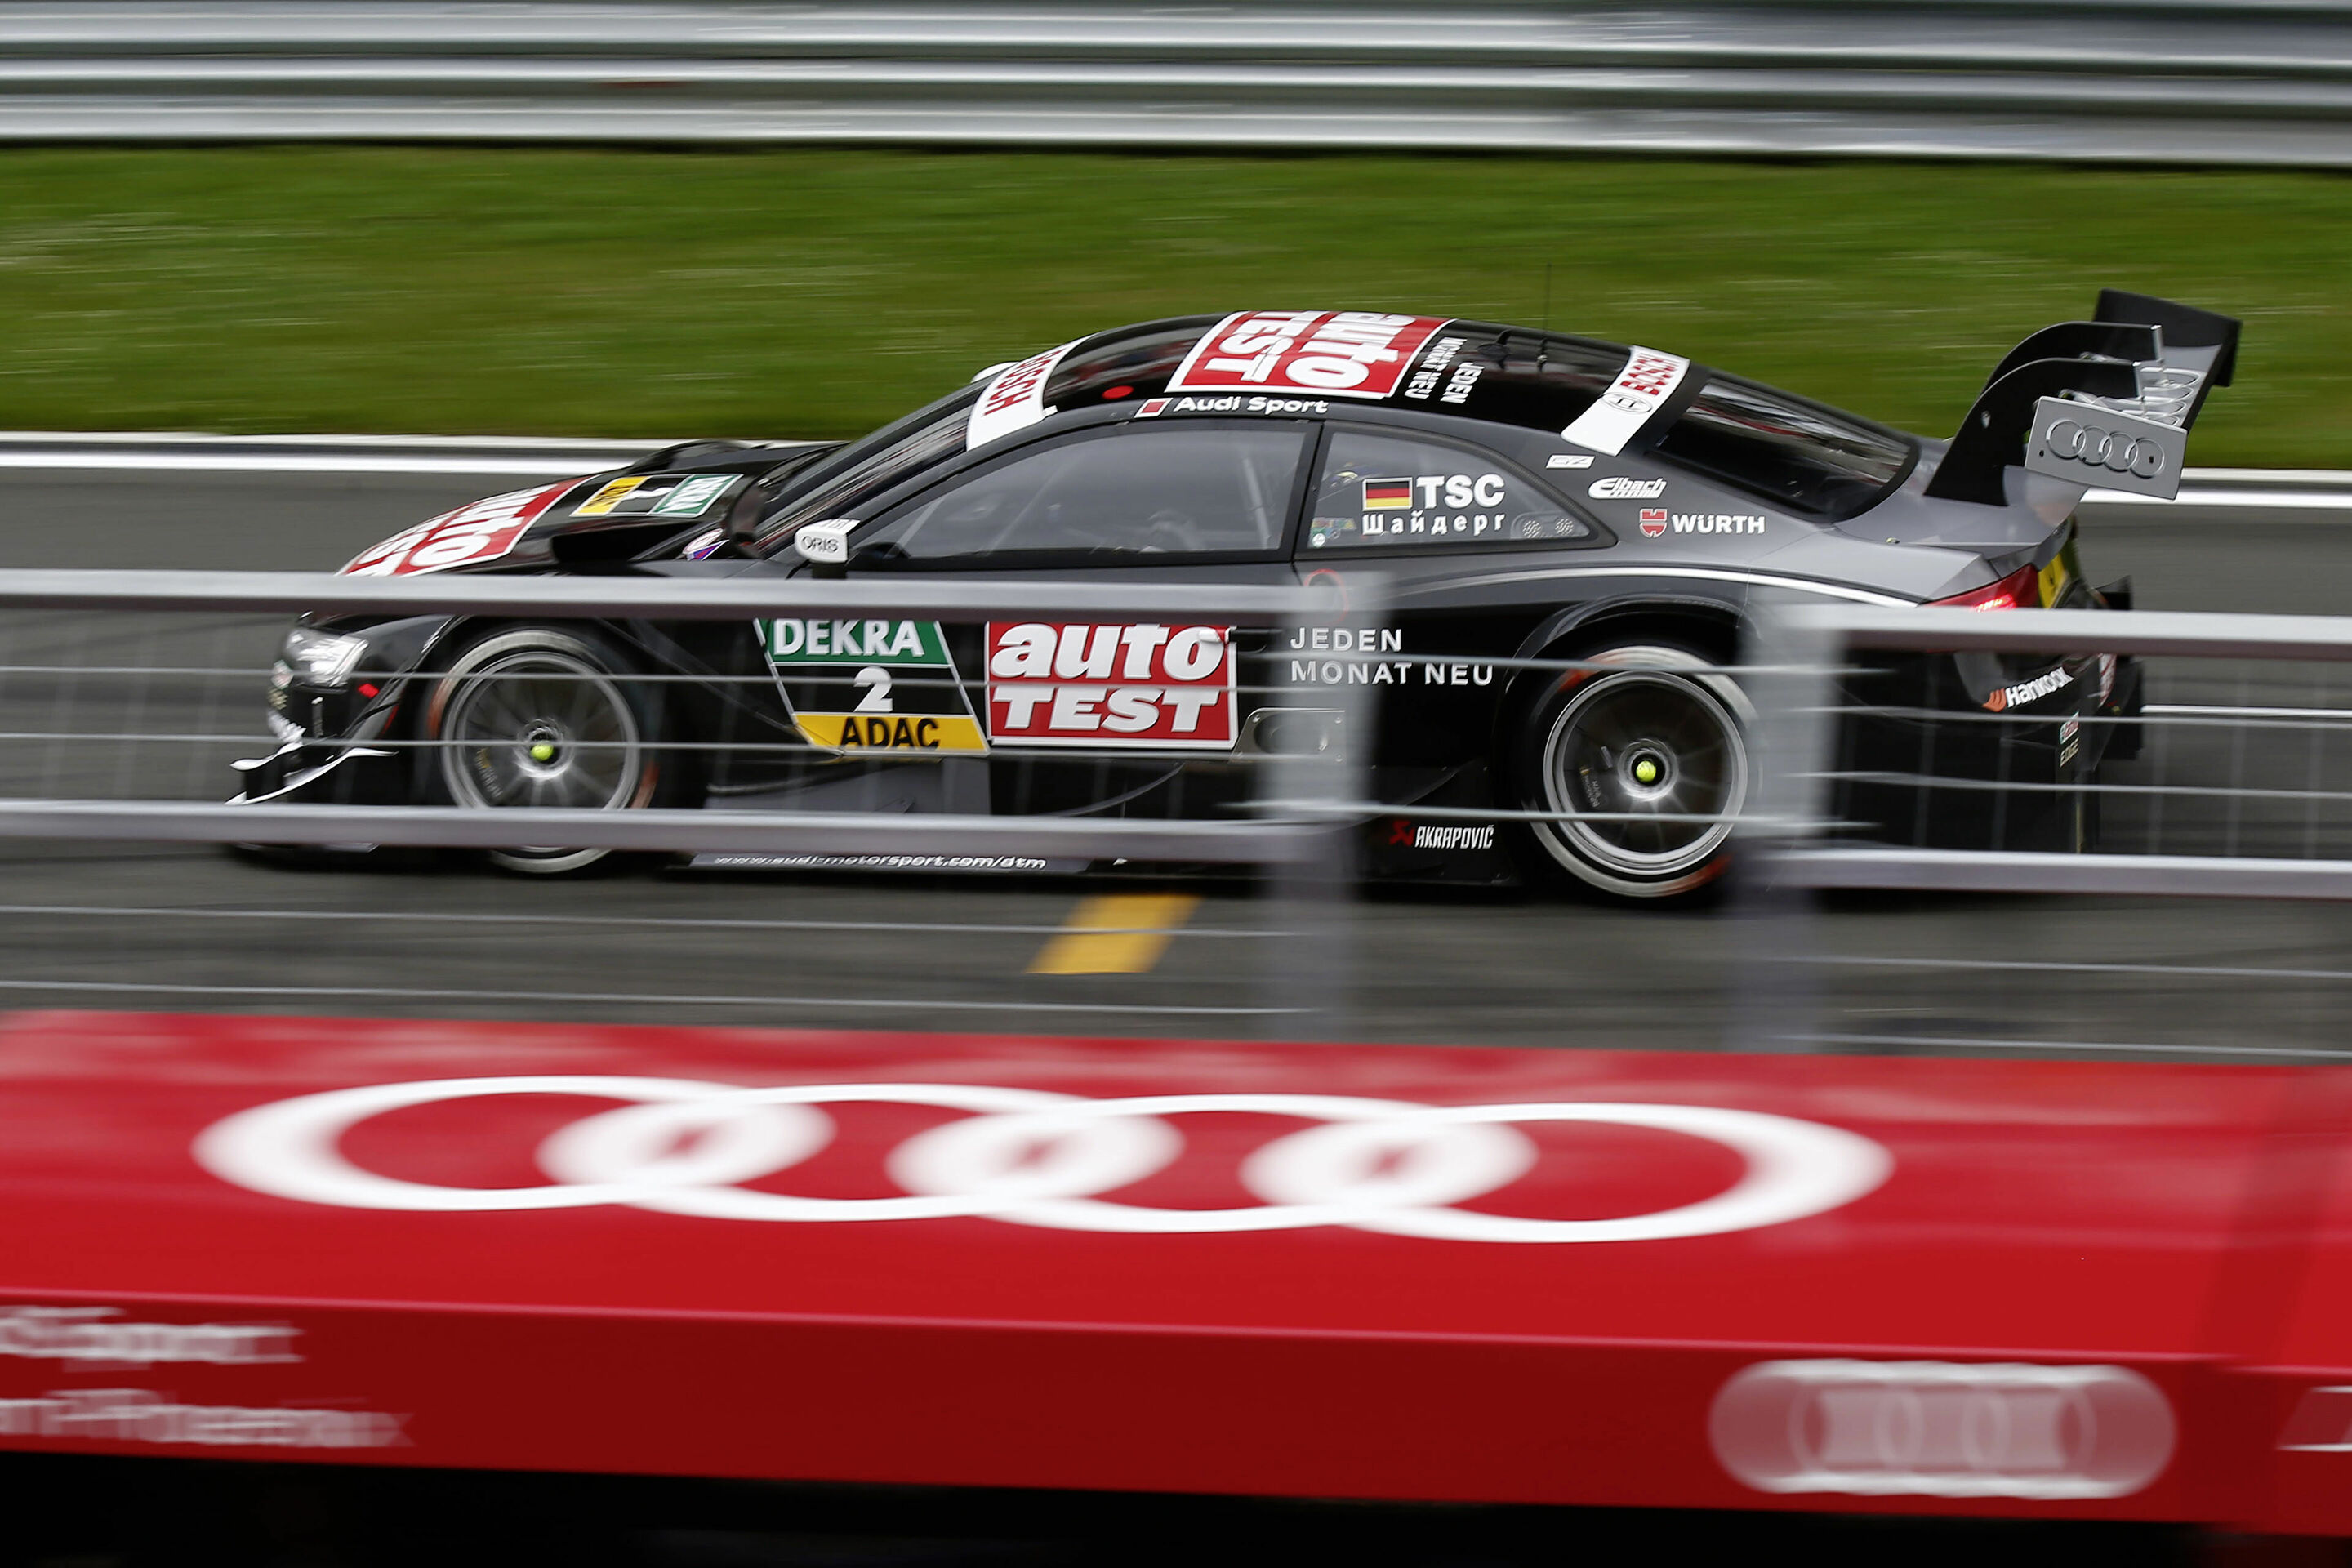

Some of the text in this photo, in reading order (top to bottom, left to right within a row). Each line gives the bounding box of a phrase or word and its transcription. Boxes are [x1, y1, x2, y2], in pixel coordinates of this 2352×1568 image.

[1205, 310, 1329, 383] TEST
[1285, 311, 1417, 389] auto
[982, 347, 1066, 416] BOSCH
[1405, 371, 1441, 399] NEU
[1440, 362, 1485, 404] JEDEN
[1619, 352, 1680, 396] BOSCH
[1174, 396, 1329, 415] Audi Sport
[1416, 474, 1505, 510] TSC
[1672, 514, 1765, 534] WÜRTH
[801, 536, 838, 554] ORIS
[773, 618, 924, 657] DEKRA
[991, 623, 1224, 682] auto
[1290, 627, 1402, 652] JEDEN
[853, 666, 893, 712] 2
[1291, 660, 1493, 685] MONAT NEU
[2005, 666, 2074, 708] Hankook
[992, 685, 1218, 733] TEST
[840, 716, 941, 749] ADAC
